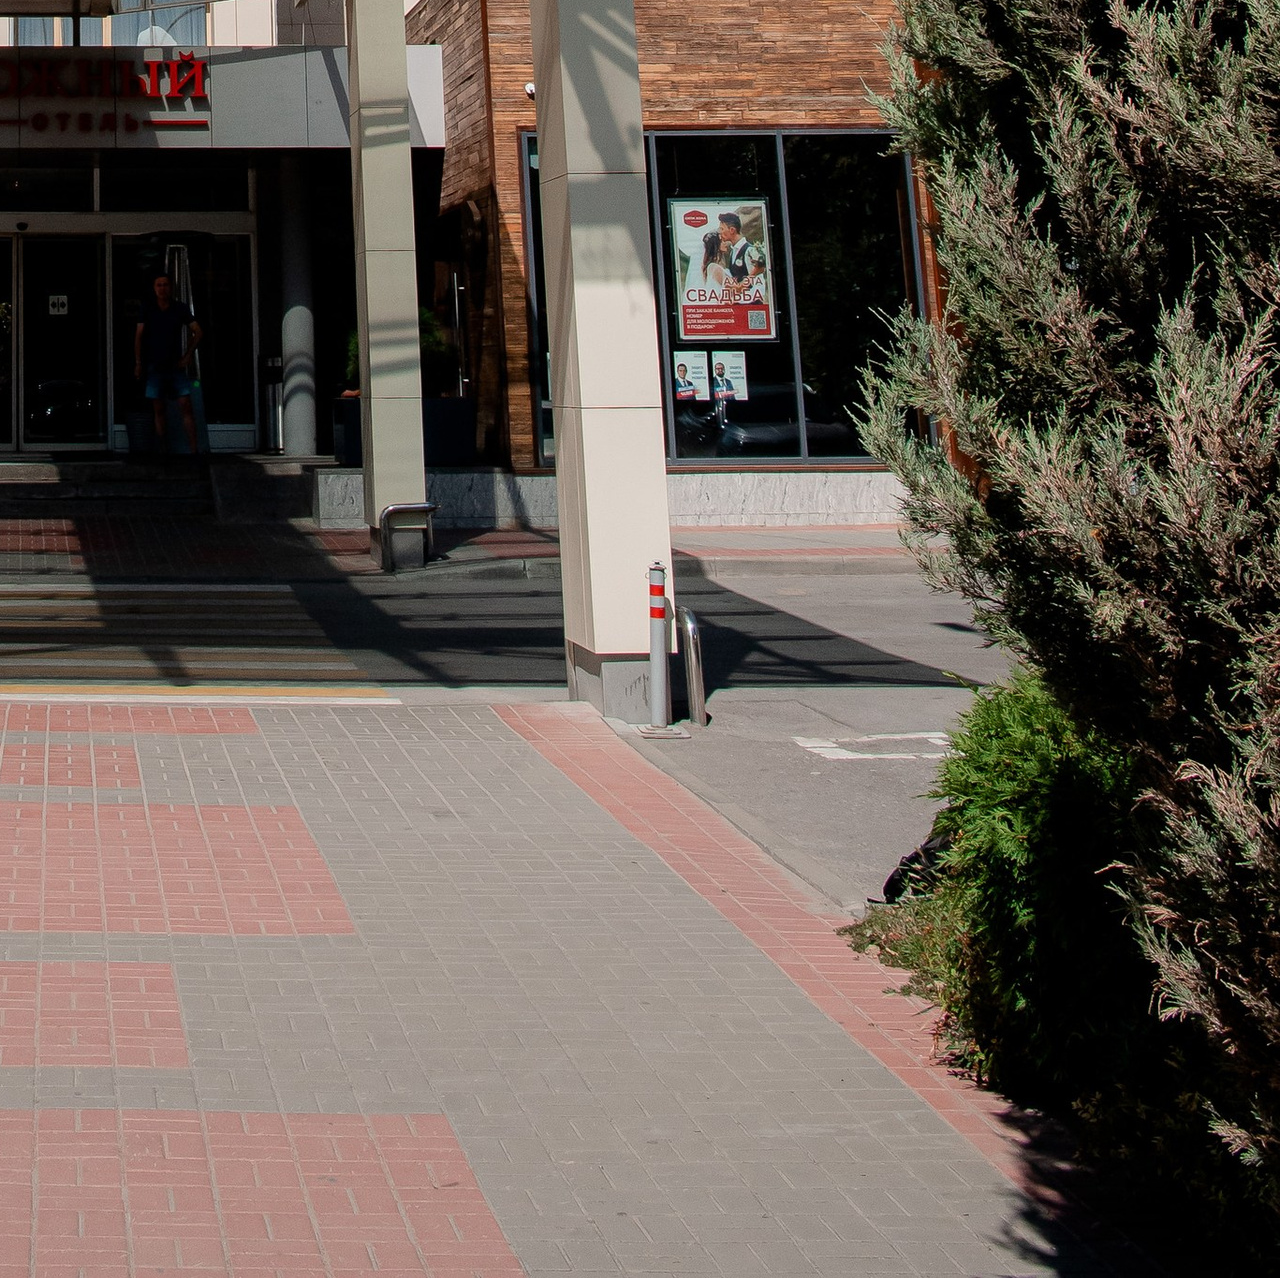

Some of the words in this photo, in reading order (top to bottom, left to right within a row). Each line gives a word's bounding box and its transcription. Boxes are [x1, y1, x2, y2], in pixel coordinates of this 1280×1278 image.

[30, 112, 140, 132] ОТЕЛЬ
[742, 275, 763, 286] ЭТА
[685, 288, 765, 304] СВАДЬБА
